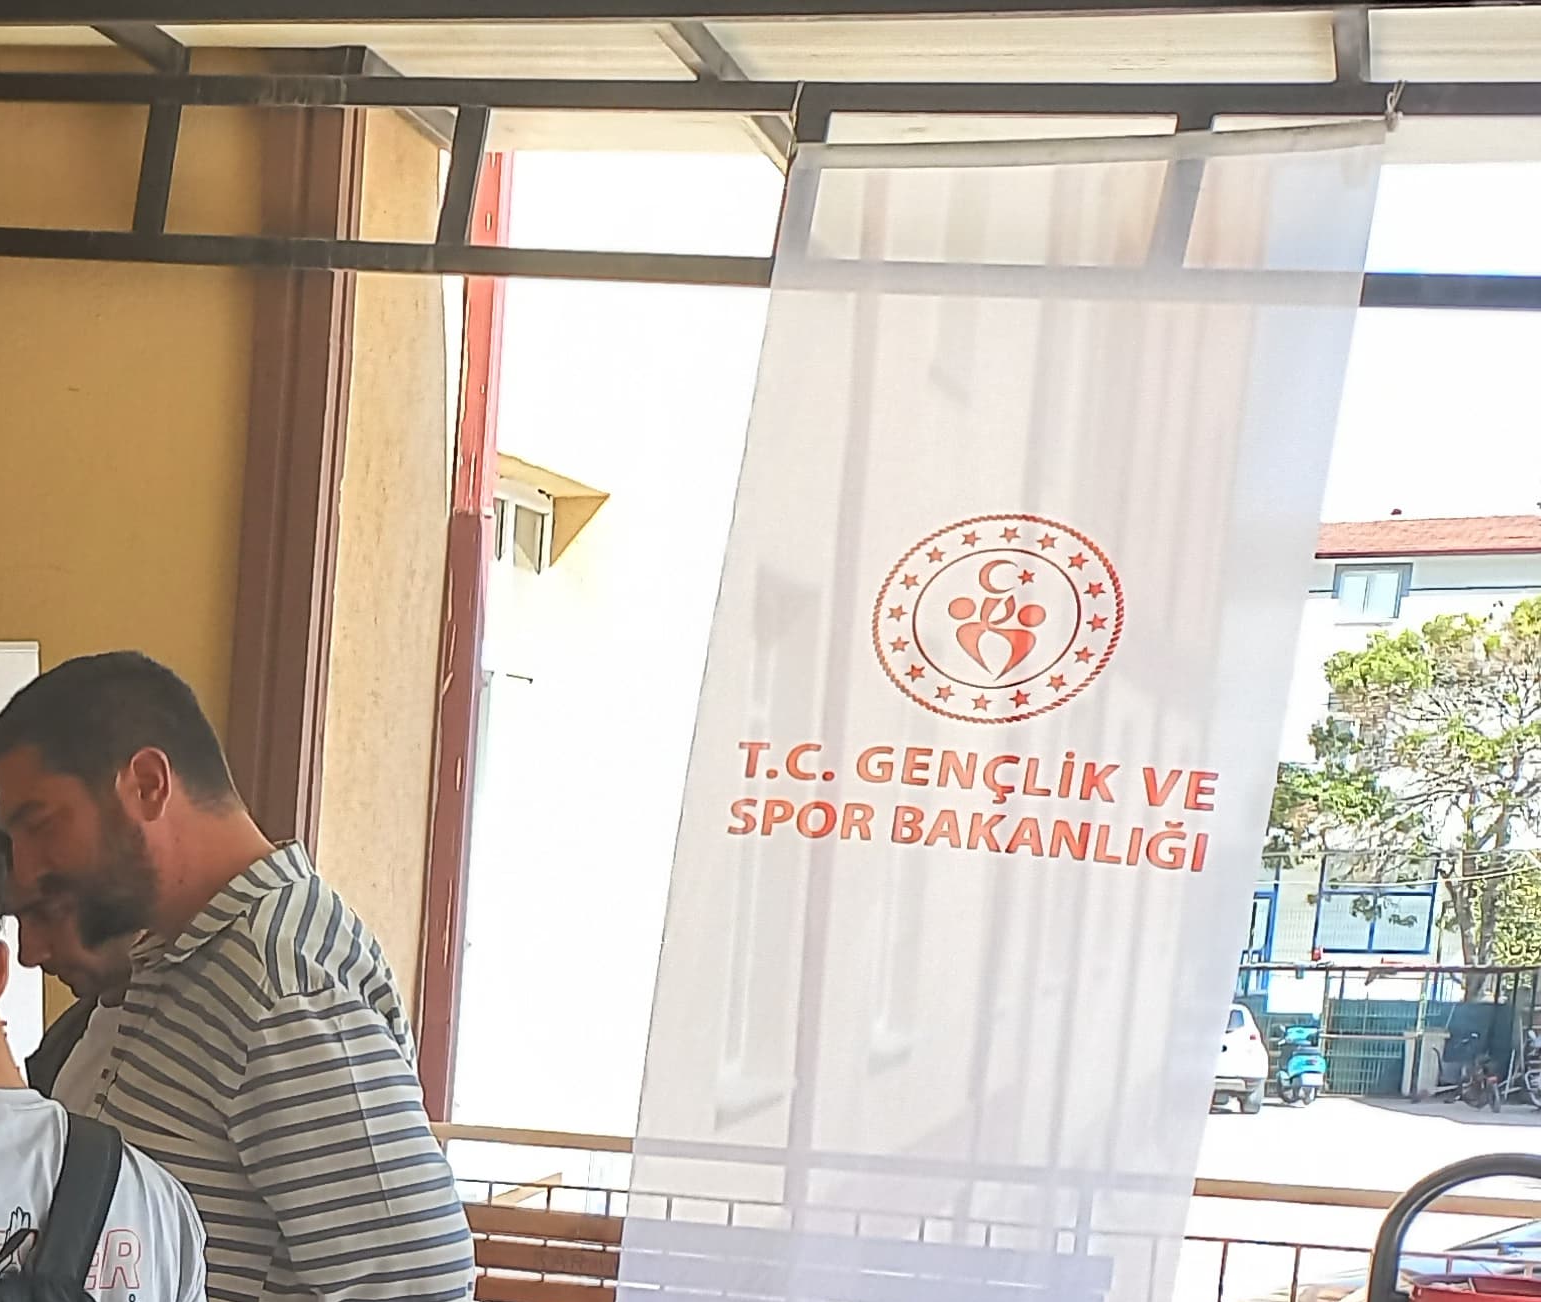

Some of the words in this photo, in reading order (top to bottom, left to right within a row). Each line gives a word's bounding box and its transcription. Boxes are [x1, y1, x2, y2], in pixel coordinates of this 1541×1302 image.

[738, 741, 836, 782] T.C.
[856, 746, 1120, 805] GENÇLİK
[1142, 767, 1220, 812] VE
[727, 798, 875, 841] SPOR
[890, 804, 1210, 873] BAKANLIĞI
